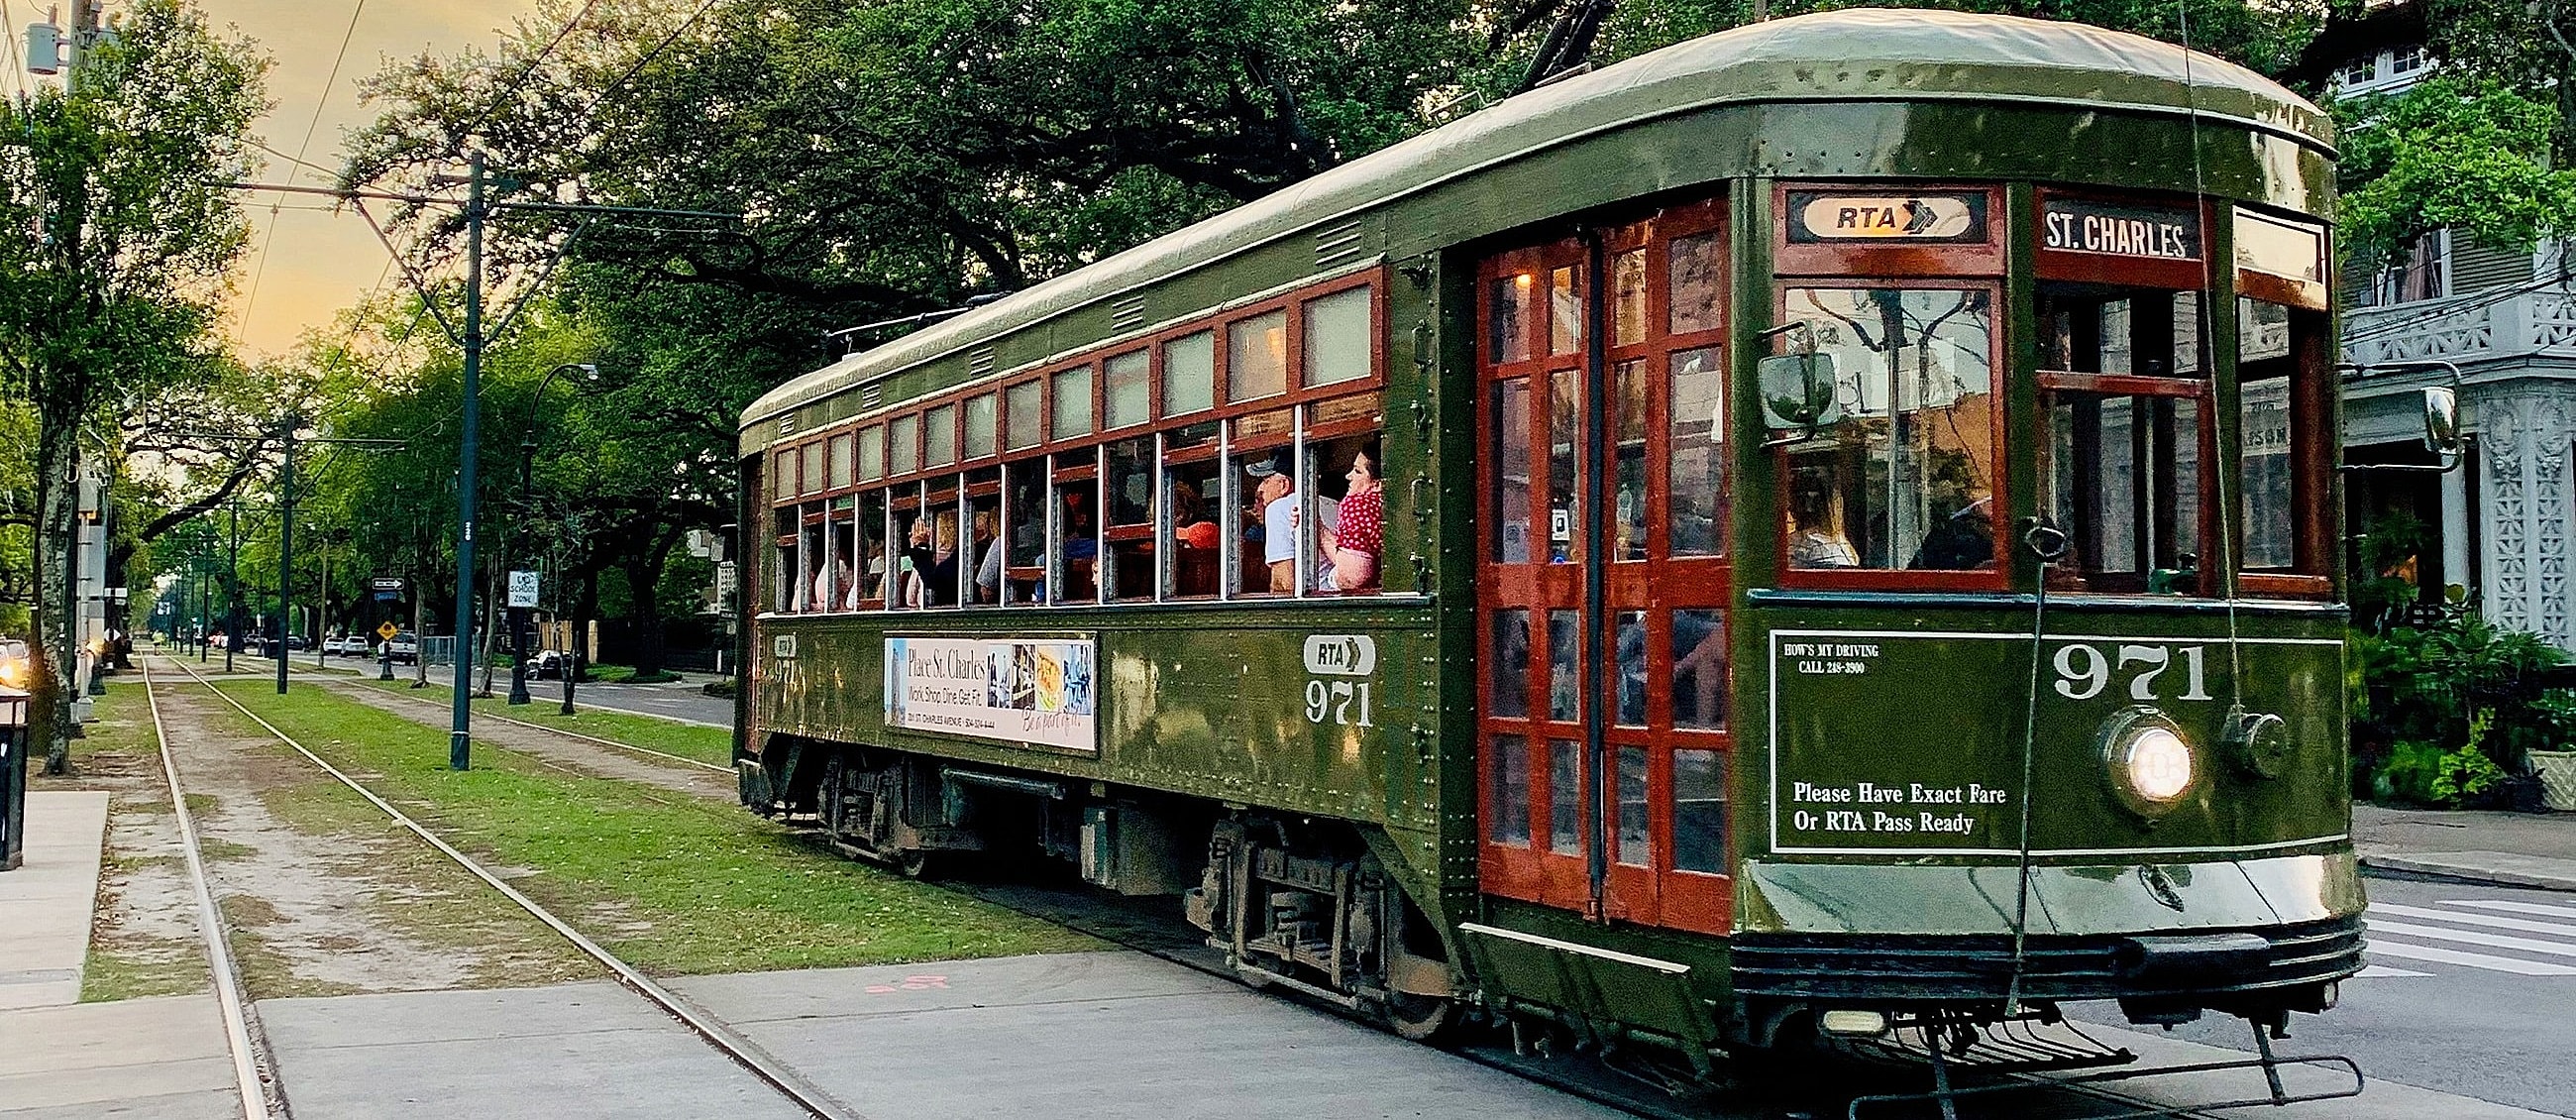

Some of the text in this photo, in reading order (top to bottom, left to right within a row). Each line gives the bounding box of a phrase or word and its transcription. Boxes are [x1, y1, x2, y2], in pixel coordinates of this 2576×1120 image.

[1837, 207, 1896, 229] RTA
[2046, 211, 2187, 259] ST. CHARLES
[513, 595, 532, 604] ZONE
[1317, 643, 1343, 666] RTA
[1783, 643, 1879, 657] HOW'S MY DRIVING
[908, 648, 986, 680] Place St. Charles
[1798, 660, 1825, 673] CALL
[2053, 643, 2213, 701] 971
[1306, 680, 1374, 727] 971
[922, 714, 943, 725] CHARLES
[943, 716, 962, 727] AVENUE
[1792, 781, 2006, 804] Please Have Exact Fare
[1793, 810, 1975, 836] Or RTA Pass Ready
